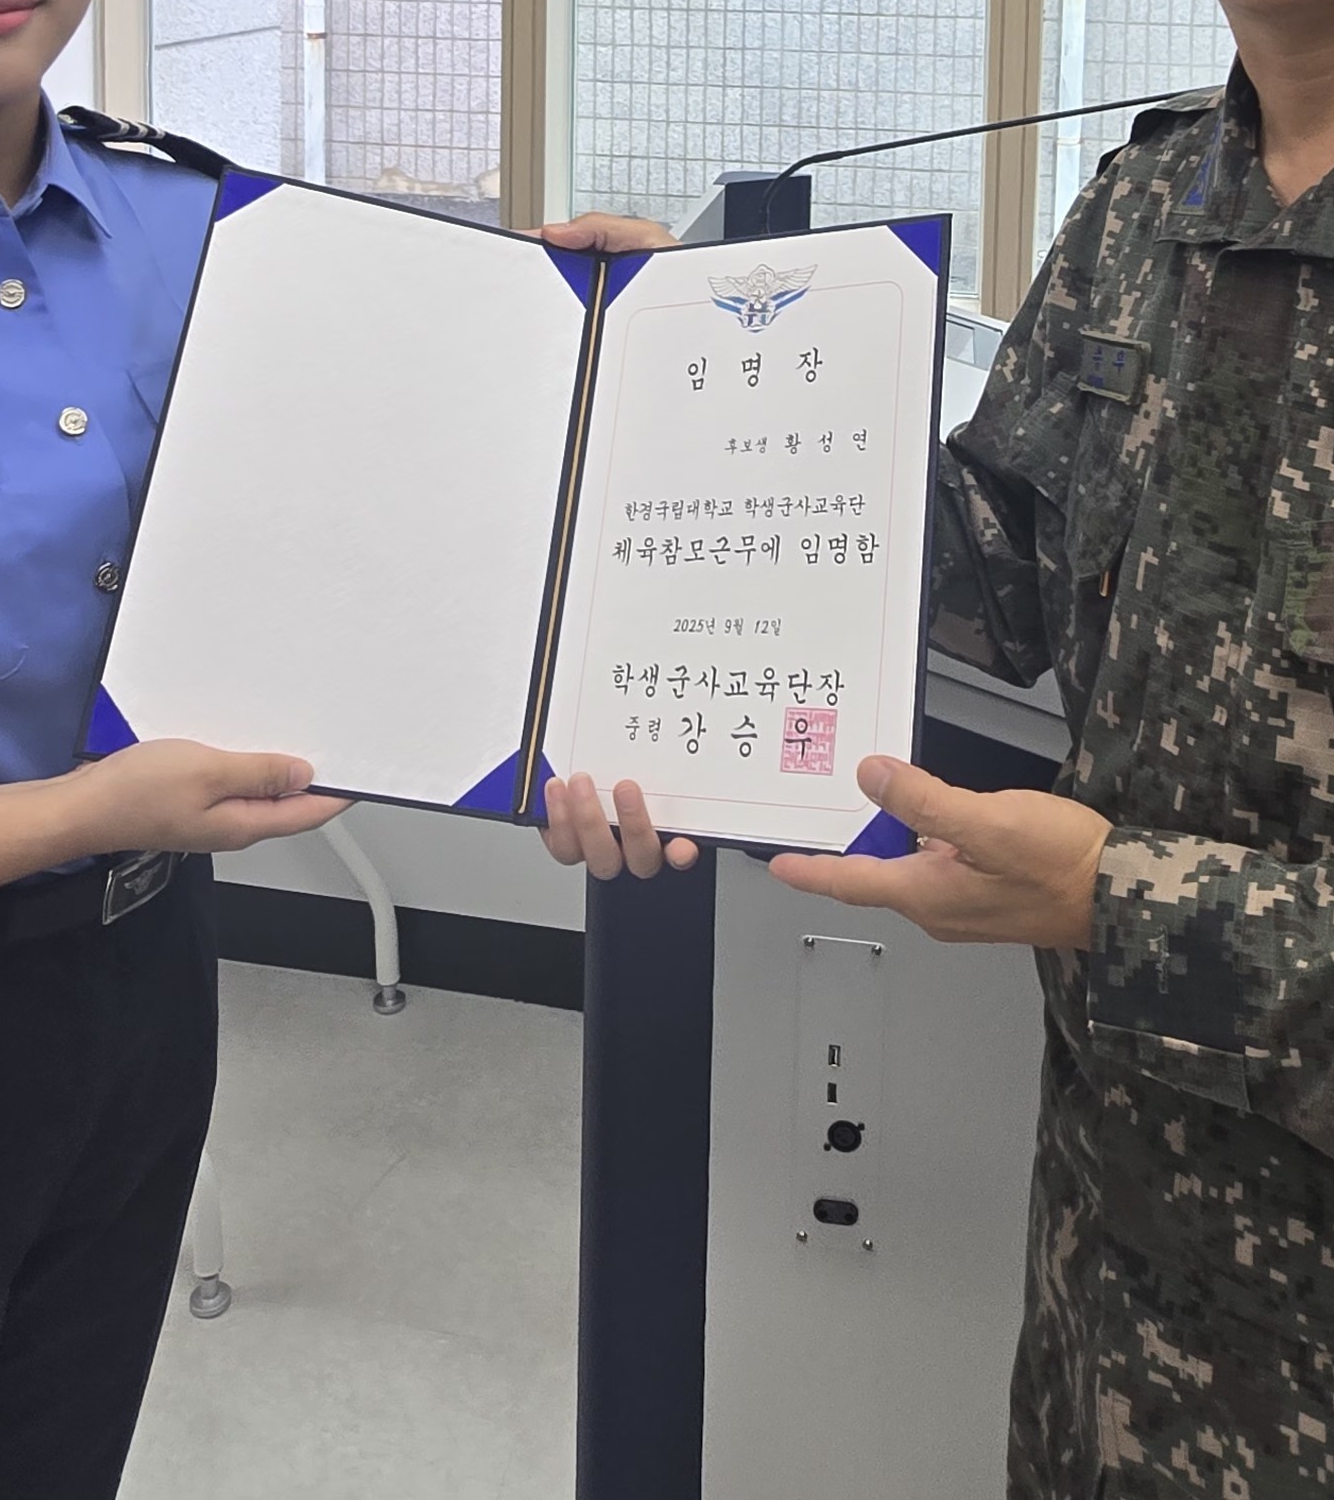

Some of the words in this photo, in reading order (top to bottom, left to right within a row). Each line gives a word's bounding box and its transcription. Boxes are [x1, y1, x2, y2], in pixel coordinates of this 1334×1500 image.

[724, 436, 768, 455] 후보생
[624, 498, 734, 522] 한경국립대학교
[744, 493, 866, 518] 학생군사교육단
[611, 533, 782, 567] 체육참모근무에
[800, 532, 880, 565] 임명함
[673, 617, 716, 636] 2025년
[724, 617, 744, 636] 9월
[754, 618, 782, 637] 12일
[612, 662, 845, 707] 학생군사교육단장
